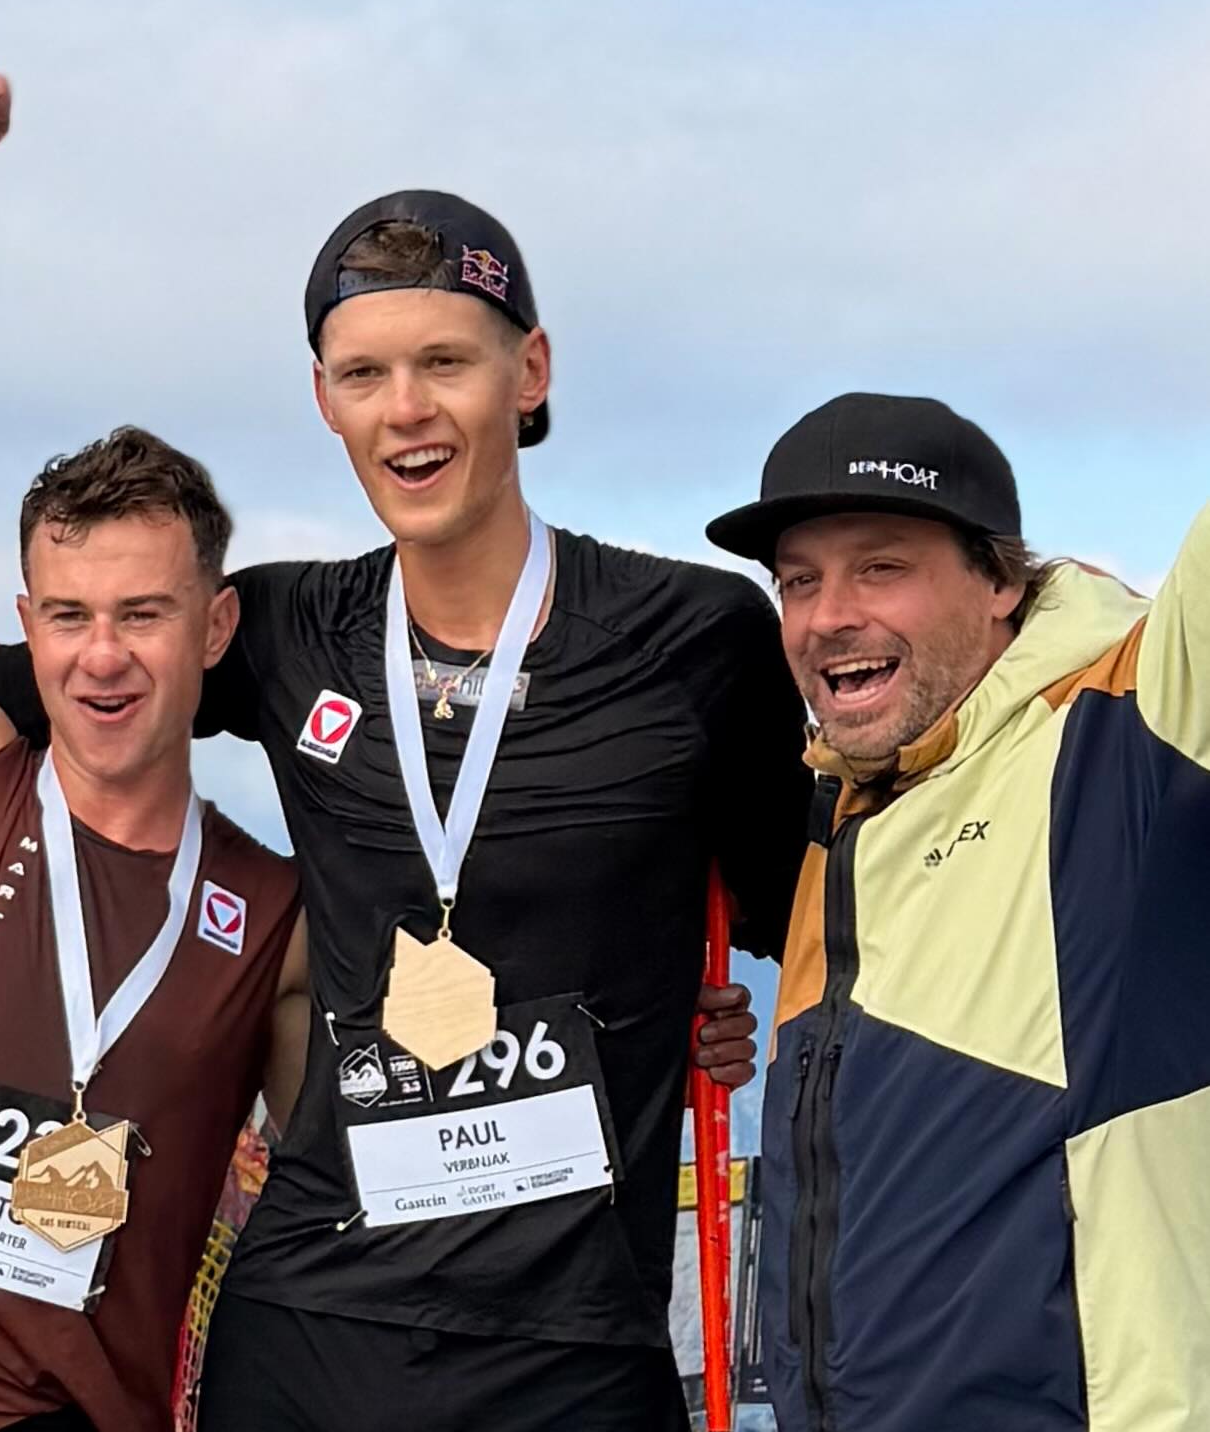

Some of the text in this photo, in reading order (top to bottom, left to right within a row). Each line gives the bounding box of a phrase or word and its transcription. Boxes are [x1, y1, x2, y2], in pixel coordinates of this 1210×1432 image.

[447, 1020, 567, 1098] 296
[438, 1119, 507, 1152] PAUL
[443, 1152, 511, 1174] VERBNJAK
[394, 1187, 448, 1212] Gastein
